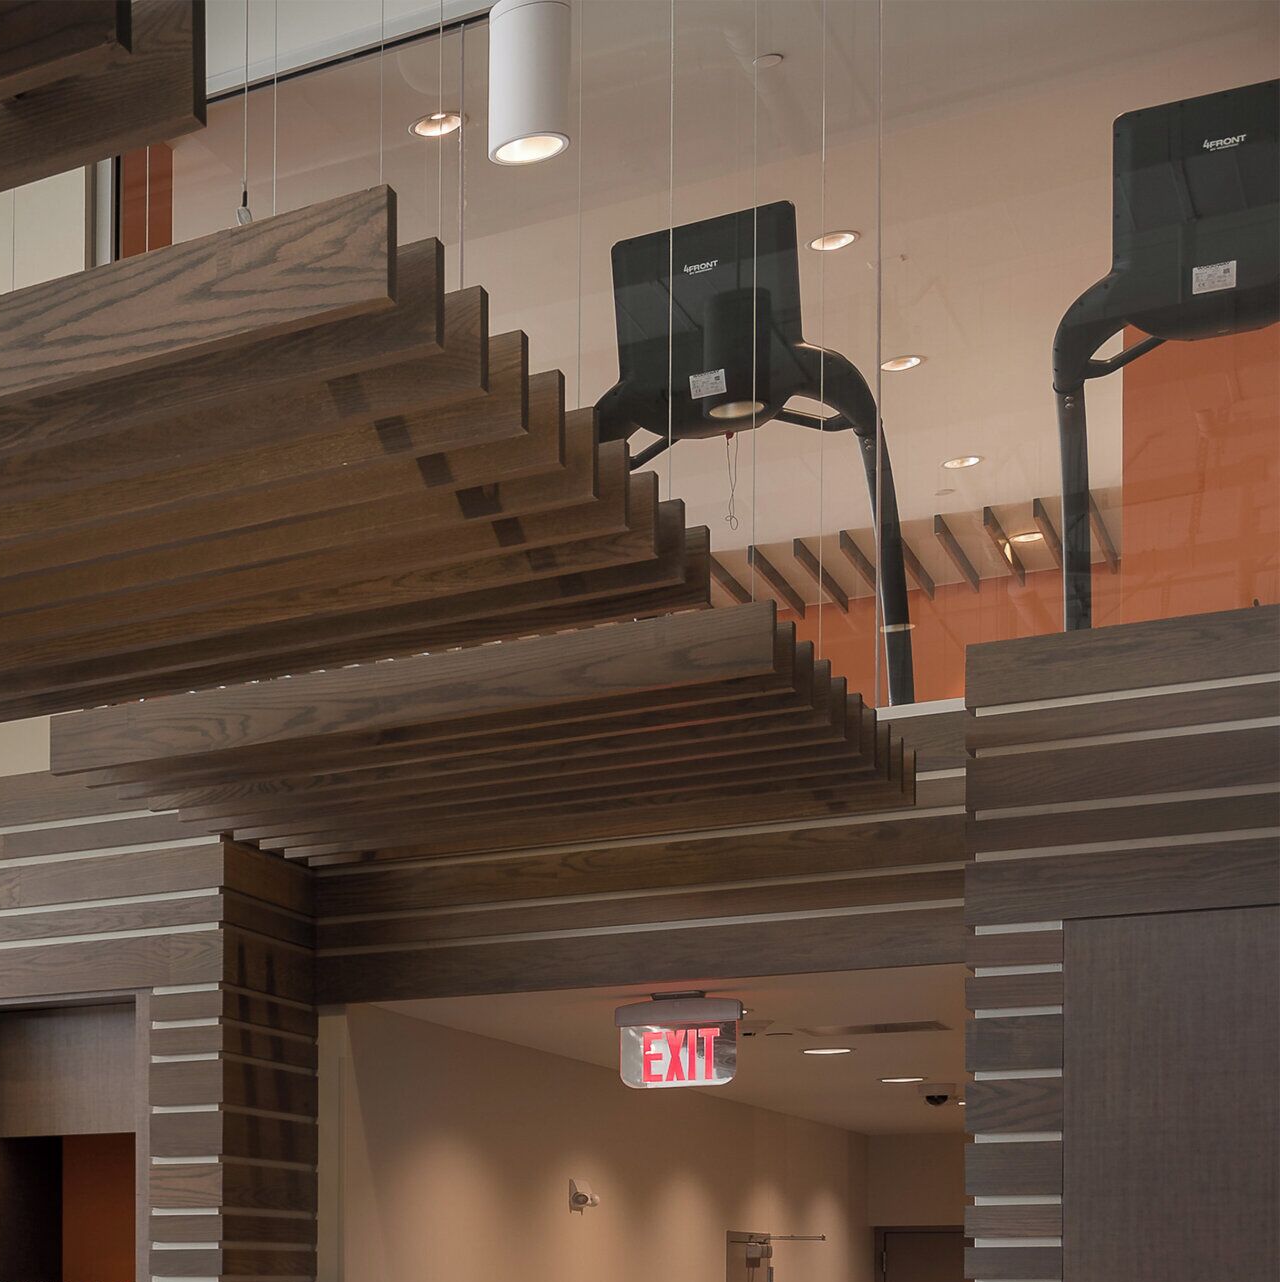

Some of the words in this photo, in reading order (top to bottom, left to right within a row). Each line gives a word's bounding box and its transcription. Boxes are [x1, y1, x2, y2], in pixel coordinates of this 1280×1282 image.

[1202, 134, 1247, 149] 4FRONT
[683, 259, 718, 273] 4FRONT
[642, 1027, 720, 1083] EXIT
